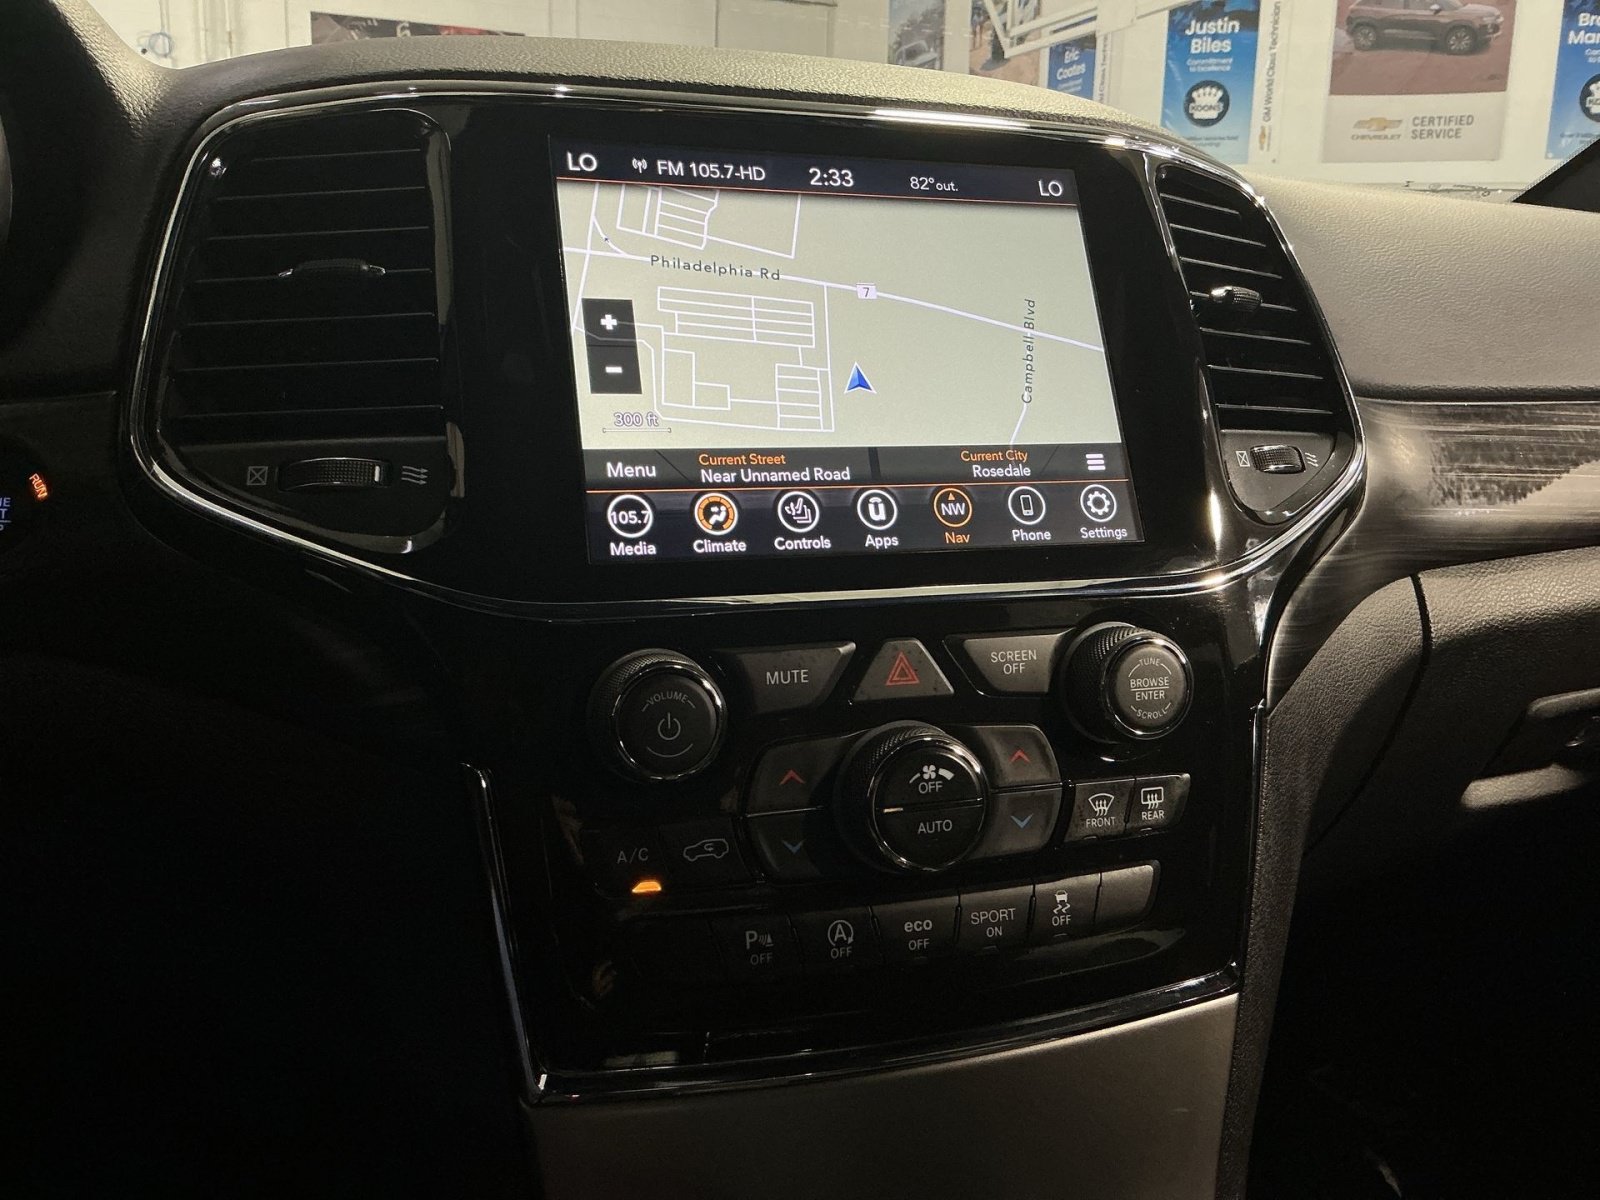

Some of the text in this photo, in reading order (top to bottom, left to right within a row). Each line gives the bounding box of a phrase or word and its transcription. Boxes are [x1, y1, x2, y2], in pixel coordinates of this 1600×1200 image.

[1184, 16, 1241, 36] Justin
[1189, 36, 1233, 55] Biles
[1411, 114, 1475, 128] CERTIFIED
[1410, 128, 1462, 140] SERVICE
[566, 151, 598, 172] LO
[656, 159, 767, 182] FM 105.7-HD
[808, 167, 855, 187] 2:33
[1037, 178, 1063, 197] LO
[649, 254, 781, 281] Philadelphia Rd
[862, 286, 871, 299] 7
[1021, 298, 1036, 405] Campbell Blvd
[613, 411, 660, 427] 300 ft
[698, 452, 787, 466] Current Street
[960, 449, 1029, 463] Current City
[606, 461, 657, 478] Menu
[700, 466, 851, 484] Near Unnamed Road
[972, 463, 1032, 478] Rosedale
[28, 472, 48, 499] RUN
[940, 502, 967, 516] NW
[610, 510, 650, 526] 105.7
[944, 531, 971, 544] Nav
[1011, 528, 1052, 542] Phone
[1079, 526, 1128, 541] Settings
[609, 541, 658, 556] Media
[693, 539, 747, 554] Climate
[774, 535, 832, 551] Controls
[864, 534, 899, 550] Apps
[990, 649, 1038, 664] SCREEN
[1138, 657, 1162, 668] TUNE
[1003, 662, 1027, 676] OFF
[765, 668, 810, 686] MUTE
[1129, 675, 1170, 689] BROWSE
[647, 690, 690, 705] VOLUME
[1134, 690, 1166, 702] ENTER
[1136, 706, 1168, 720] SCROLL
[918, 780, 943, 795] OFF
[1141, 808, 1166, 821] REAR
[917, 819, 954, 835] AUTO
[1085, 816, 1117, 829] FRONT
[616, 846, 650, 865] A/C
[970, 907, 1017, 926] SPORT
[1051, 914, 1072, 927] OFF
[903, 919, 934, 933] eco
[985, 926, 1003, 939] ON
[908, 938, 931, 951] OFF
[750, 952, 774, 966] OFF
[830, 946, 853, 960] OFF
